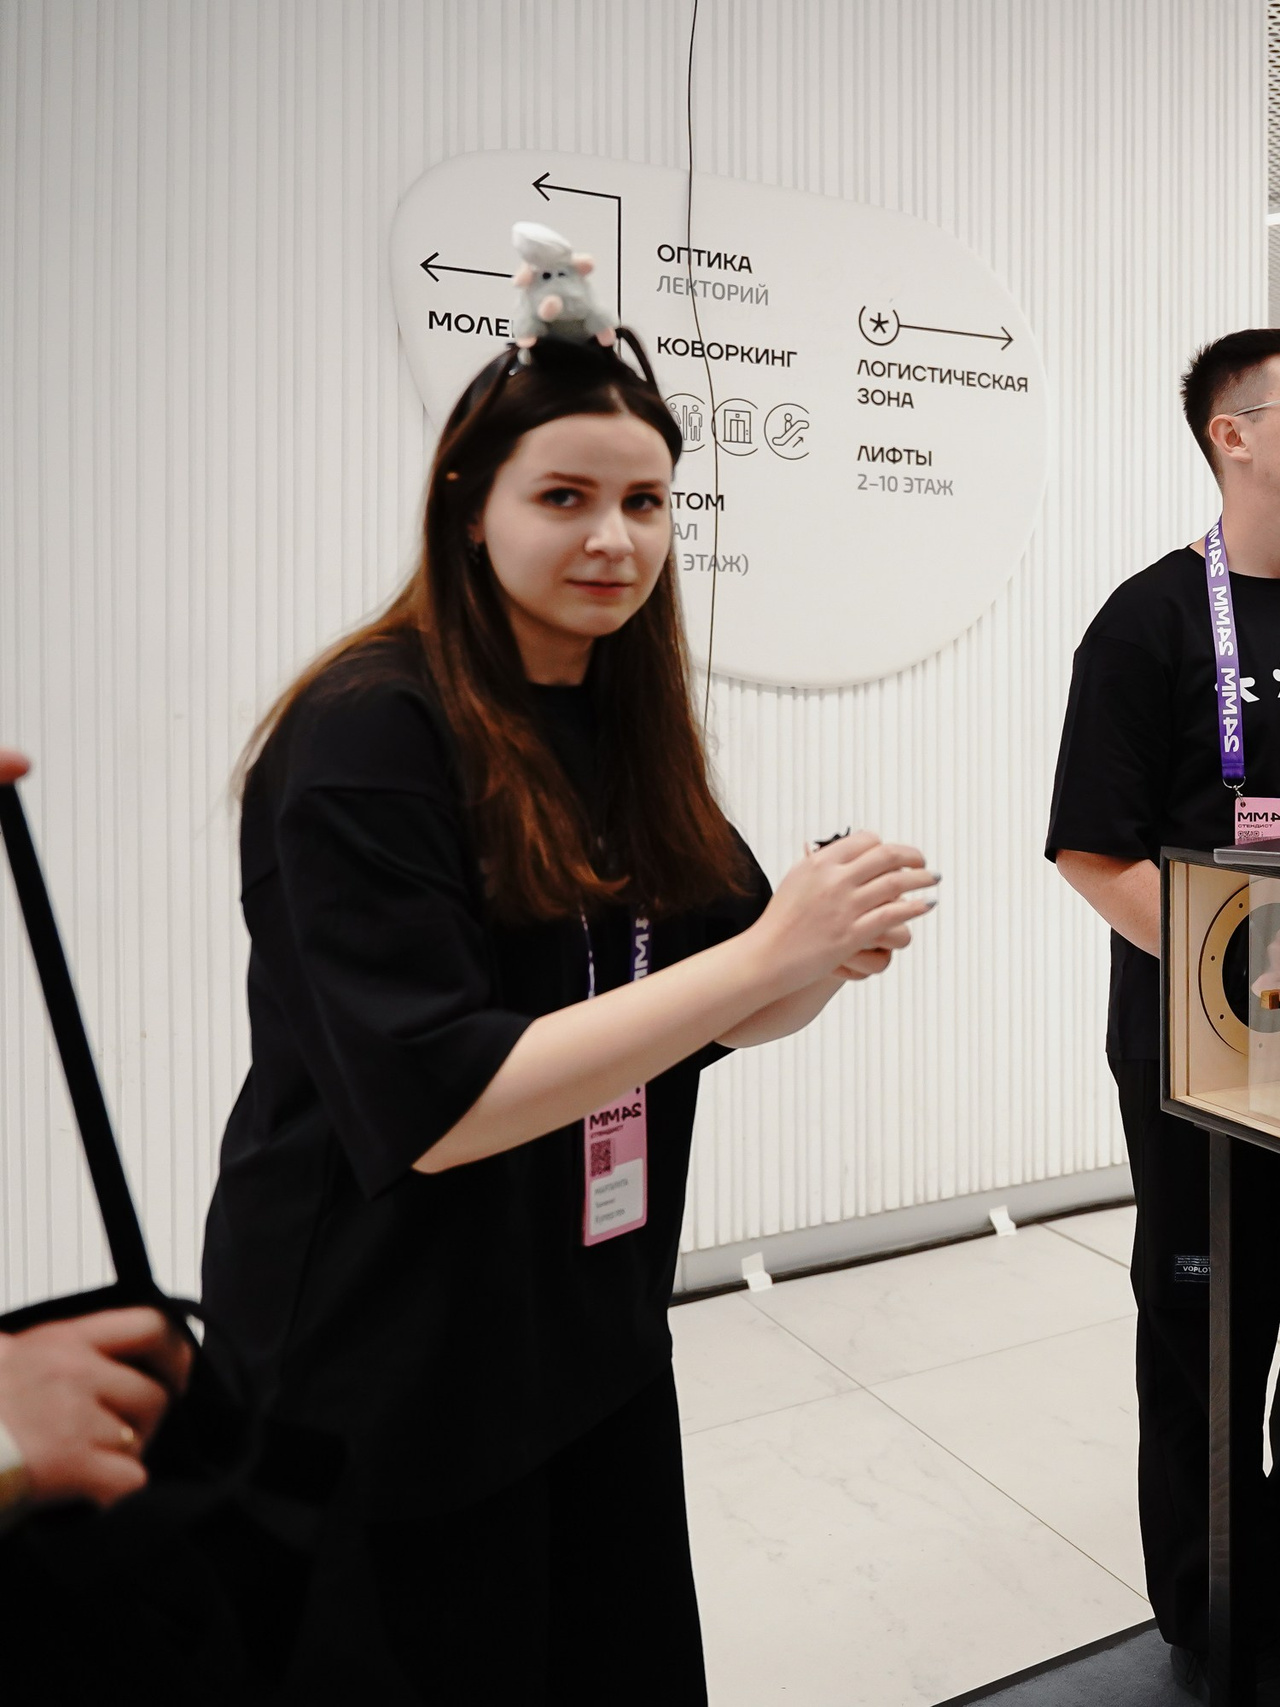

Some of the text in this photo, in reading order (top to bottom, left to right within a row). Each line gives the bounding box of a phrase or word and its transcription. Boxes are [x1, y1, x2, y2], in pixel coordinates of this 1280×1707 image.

[657, 244, 753, 274] ОПТИКА
[656, 275, 769, 306] ЛЕКТОРИЙ
[428, 310, 515, 338] МОЛЕ
[657, 336, 798, 368] КОВОРКИНГ
[857, 359, 1029, 393] ЛОГИСТИЧЕСКАЯ
[857, 388, 914, 409] ЗОНА
[857, 445, 932, 466] ЛИФТЫ
[903, 476, 954, 496] ЭТАЖ
[669, 492, 725, 511] ТОМ
[673, 522, 698, 541] АЛ
